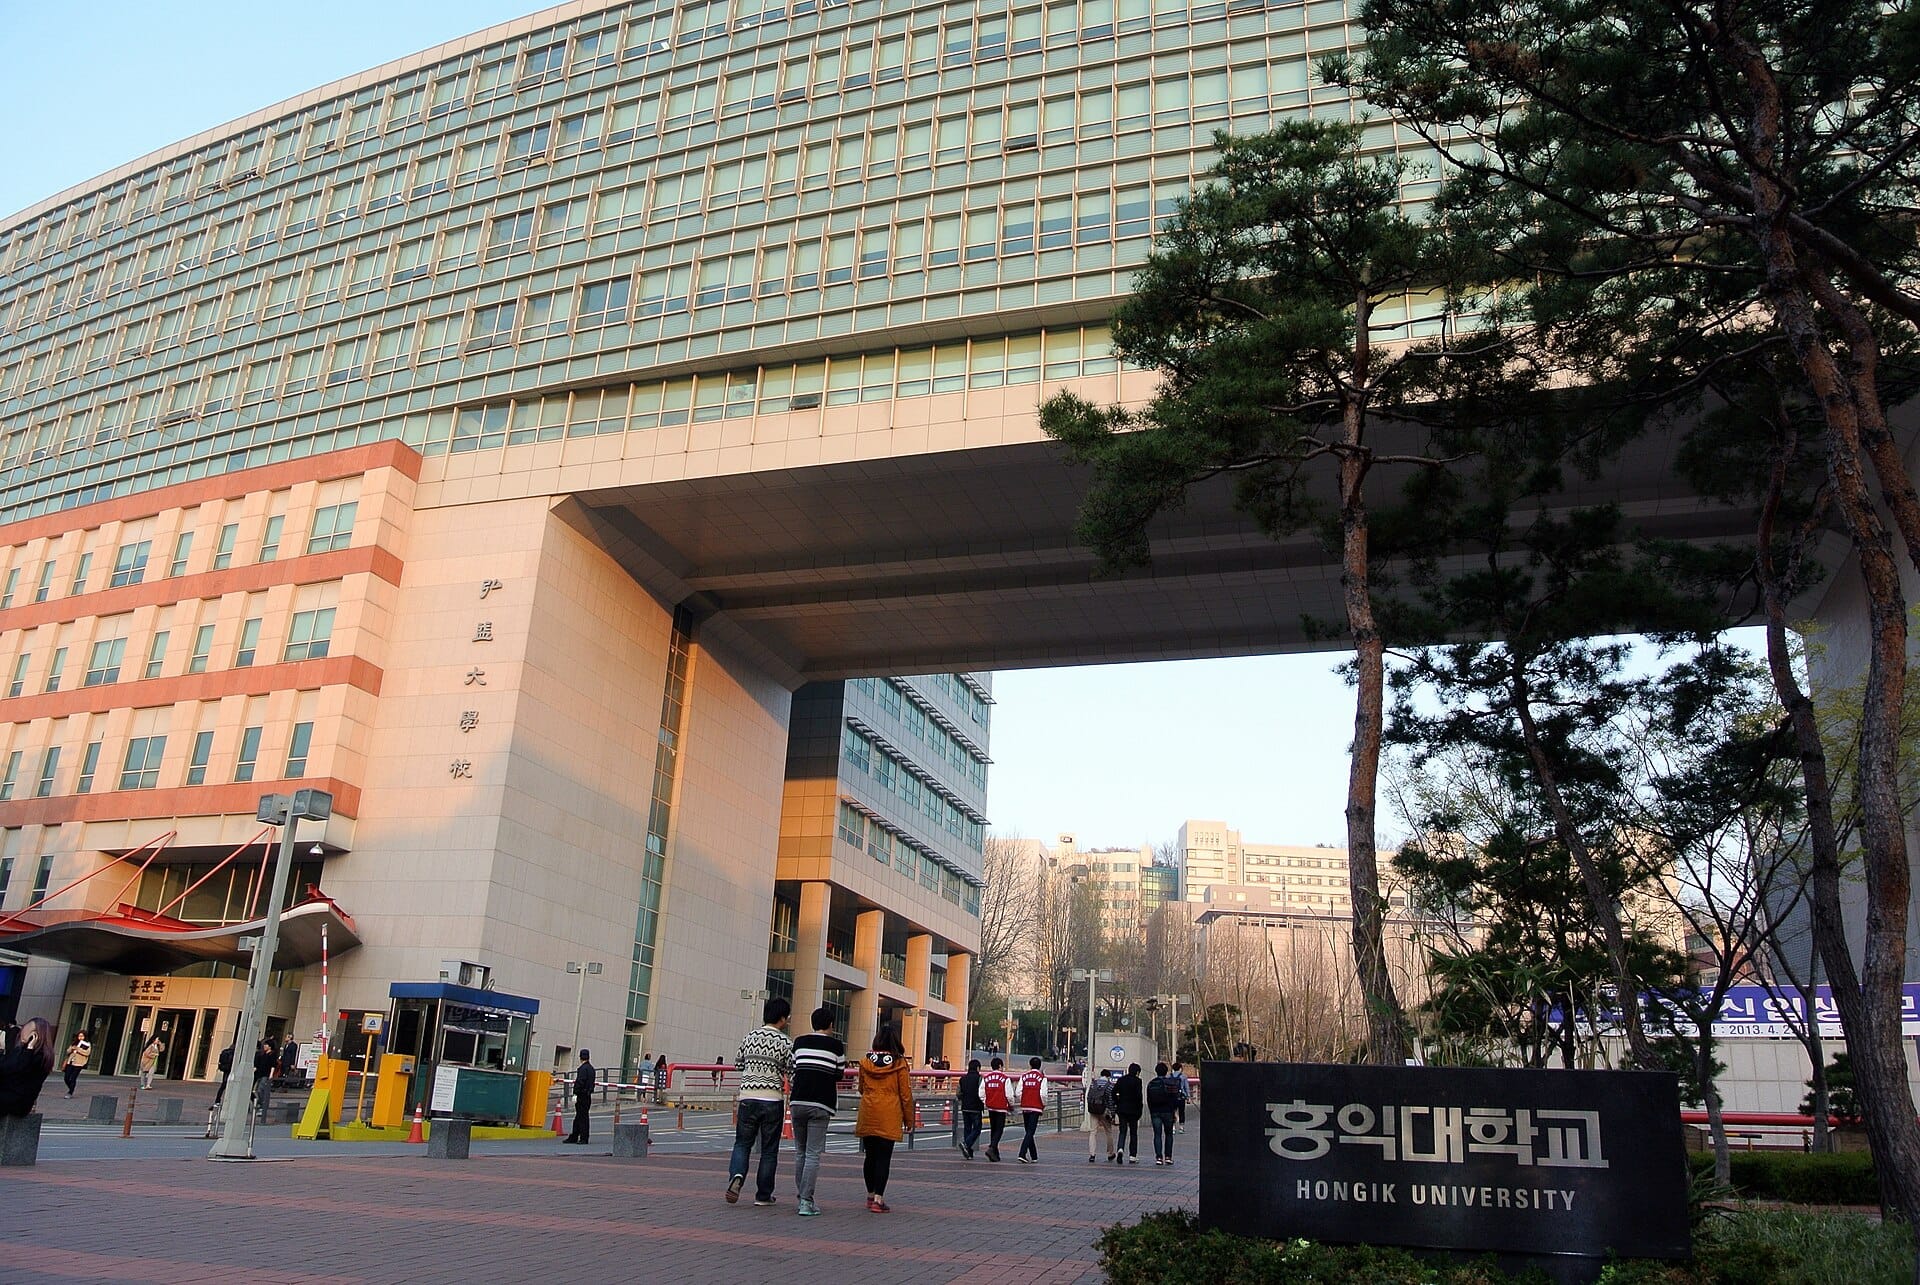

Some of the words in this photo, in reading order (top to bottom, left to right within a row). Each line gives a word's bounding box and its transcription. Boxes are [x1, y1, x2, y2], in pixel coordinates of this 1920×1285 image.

[449, 578, 503, 780] 弘益大學校
[129, 979, 166, 993] 홍문관
[1729, 1024, 1764, 1035] 2013.
[1264, 1099, 1610, 1169] 홍익대학교
[1297, 1179, 1397, 1204] HONGIK
[1411, 1184, 1577, 1211] UNIVERSITY
